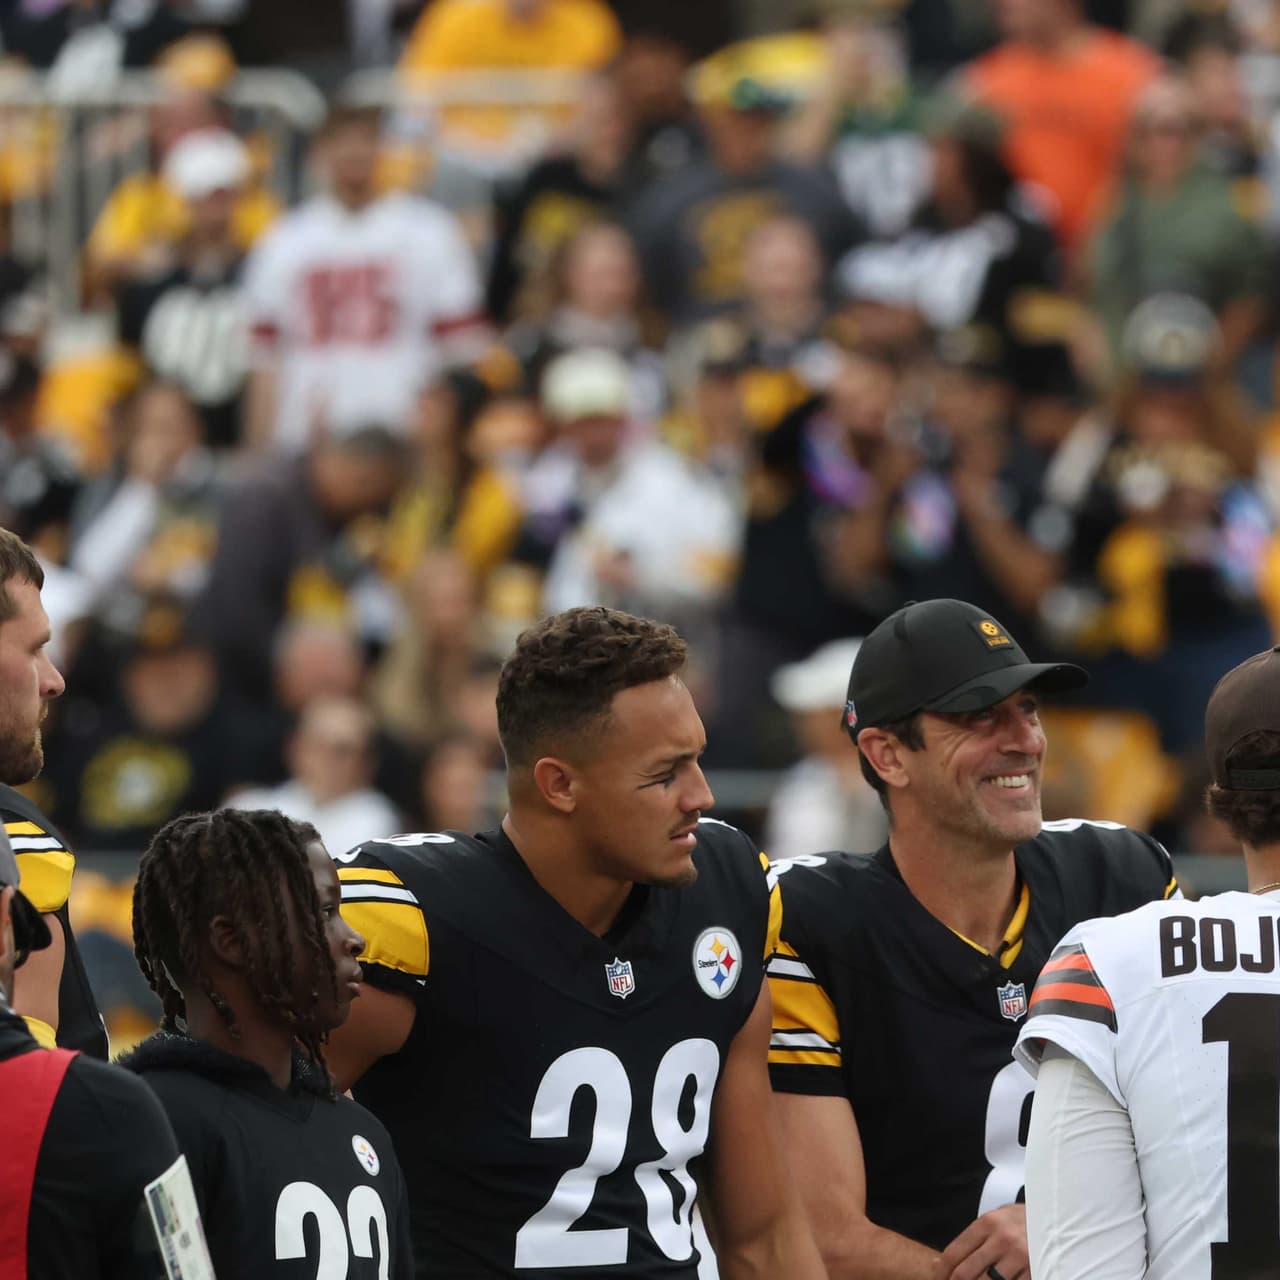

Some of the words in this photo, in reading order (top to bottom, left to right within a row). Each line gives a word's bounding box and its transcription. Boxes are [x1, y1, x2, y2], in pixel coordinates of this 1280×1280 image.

[613, 977, 632, 992] NFL
[1004, 999, 1024, 1015] NFL
[514, 1038, 720, 1268] 28
